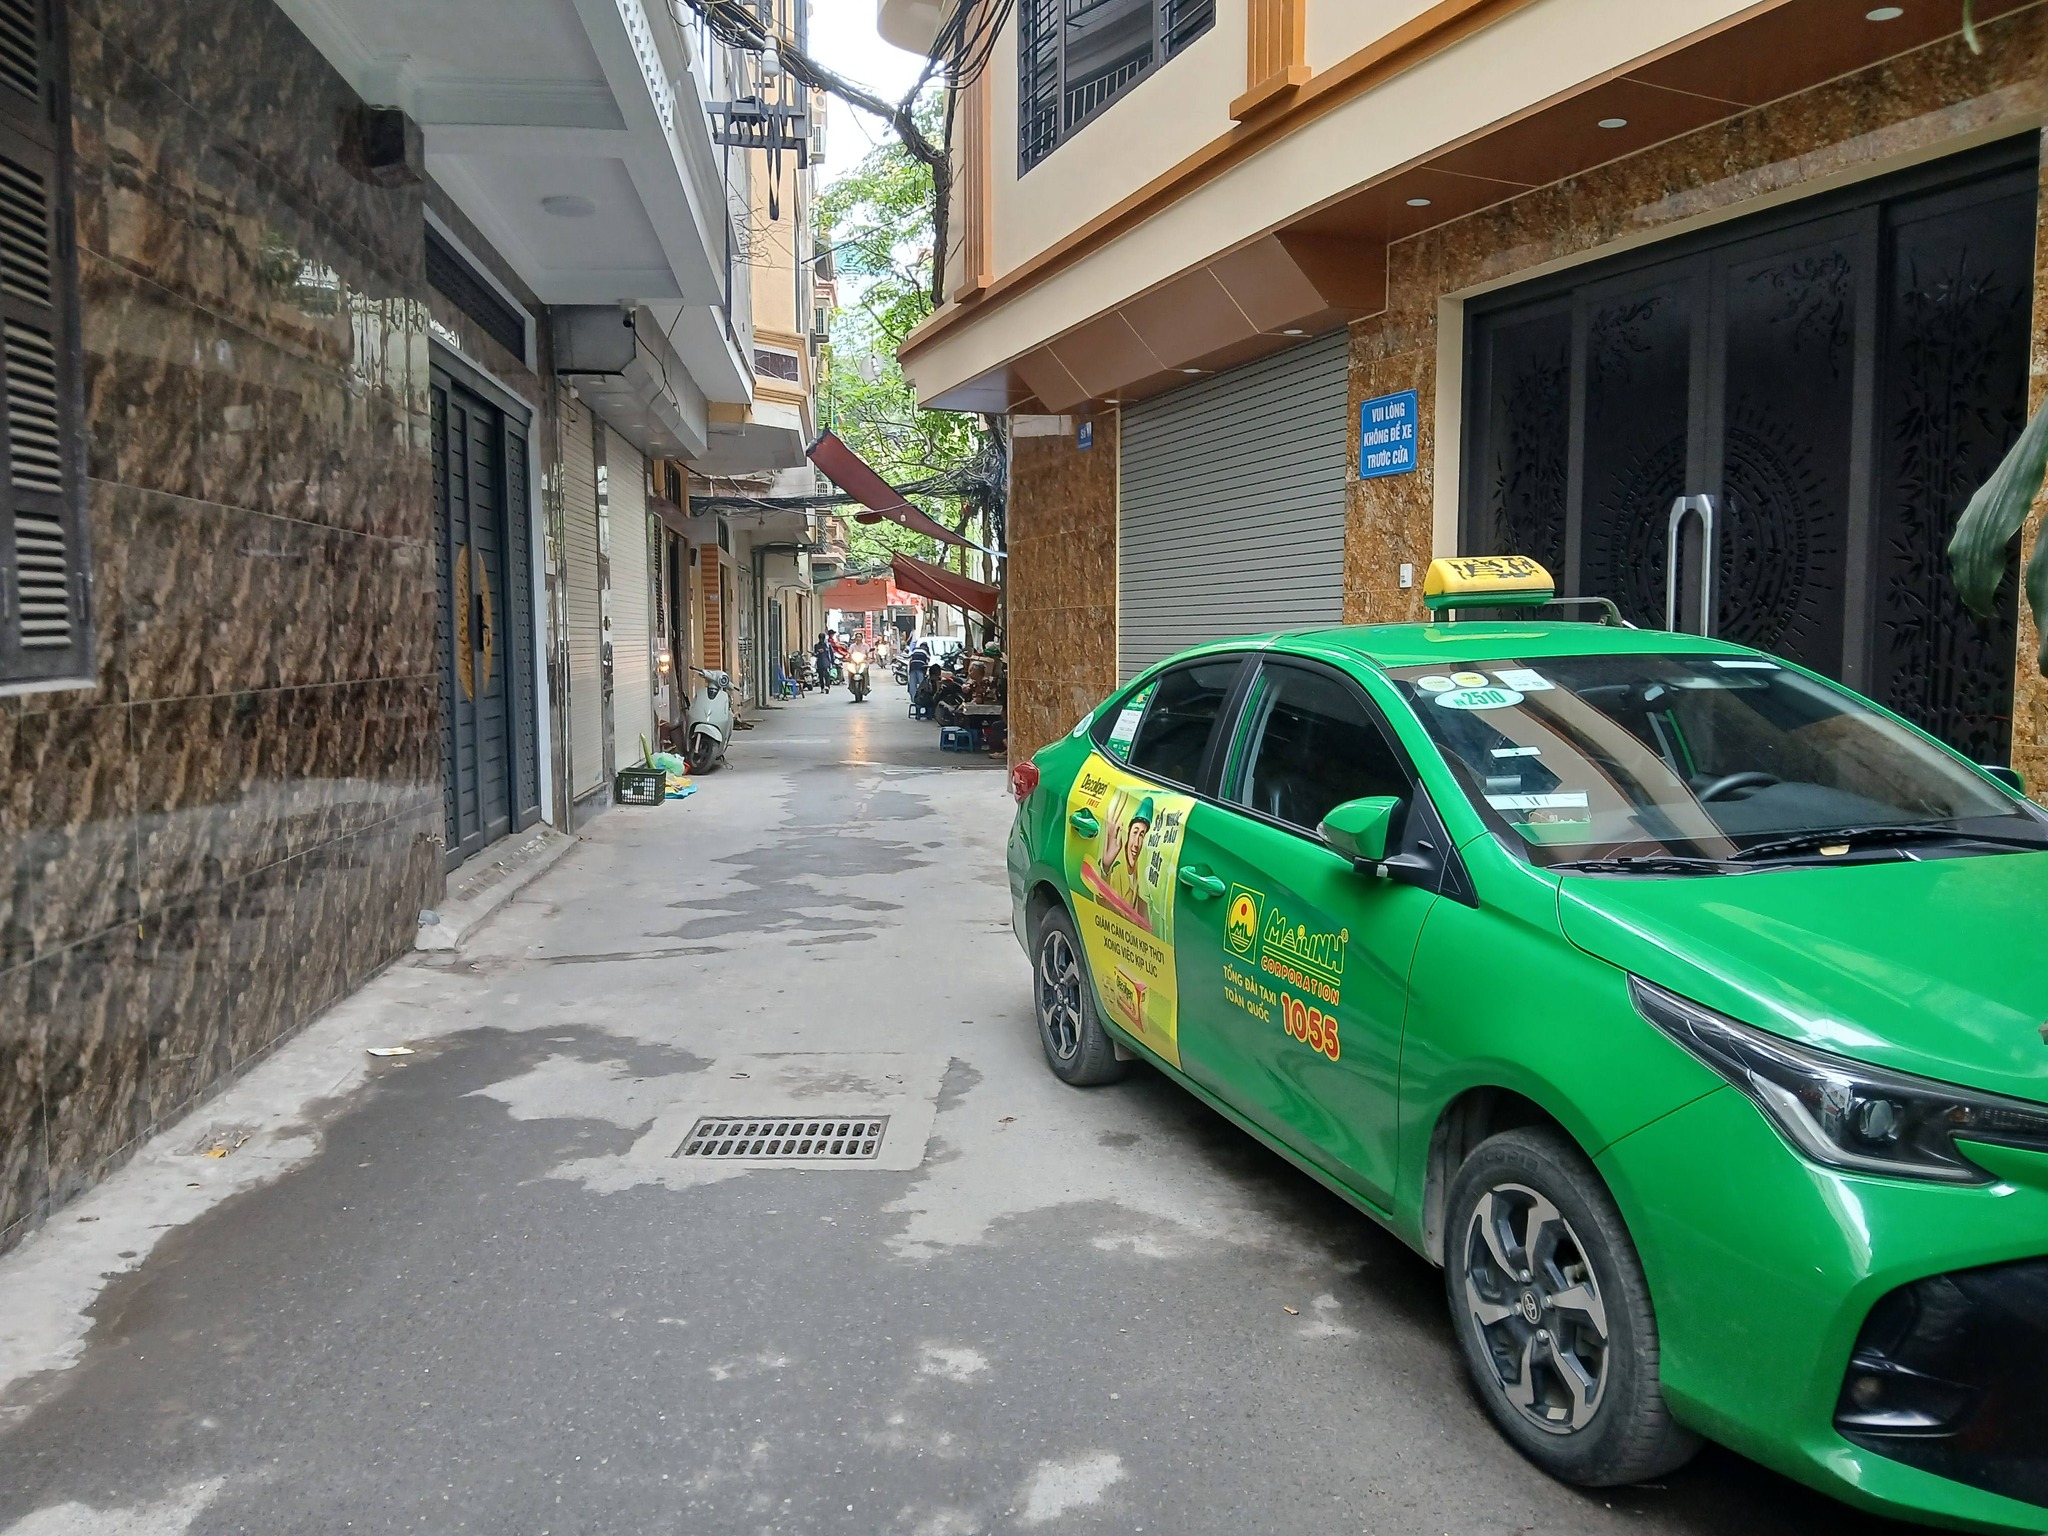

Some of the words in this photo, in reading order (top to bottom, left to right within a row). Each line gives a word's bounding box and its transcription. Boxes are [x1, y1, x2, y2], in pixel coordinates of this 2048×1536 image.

[1372, 407, 1384, 423] VUI
[1385, 401, 1405, 420] LÒNG
[1363, 428, 1389, 447] KHÔNG
[1402, 423, 1412, 440] XE
[1367, 449, 1391, 469] TRƯỚC
[1392, 445, 1409, 465] CỬA
[1103, 936, 1121, 955] XONG
[1223, 963, 1243, 987] TỔNG
[1244, 975, 1258, 996] ĐÀI
[1259, 985, 1277, 1007] TAXI
[1261, 955, 1340, 1006] CORPORATION
[1224, 985, 1245, 1009] TOÀN
[1247, 1001, 1270, 1023] QUỐC
[1280, 992, 1341, 1062] 1055
